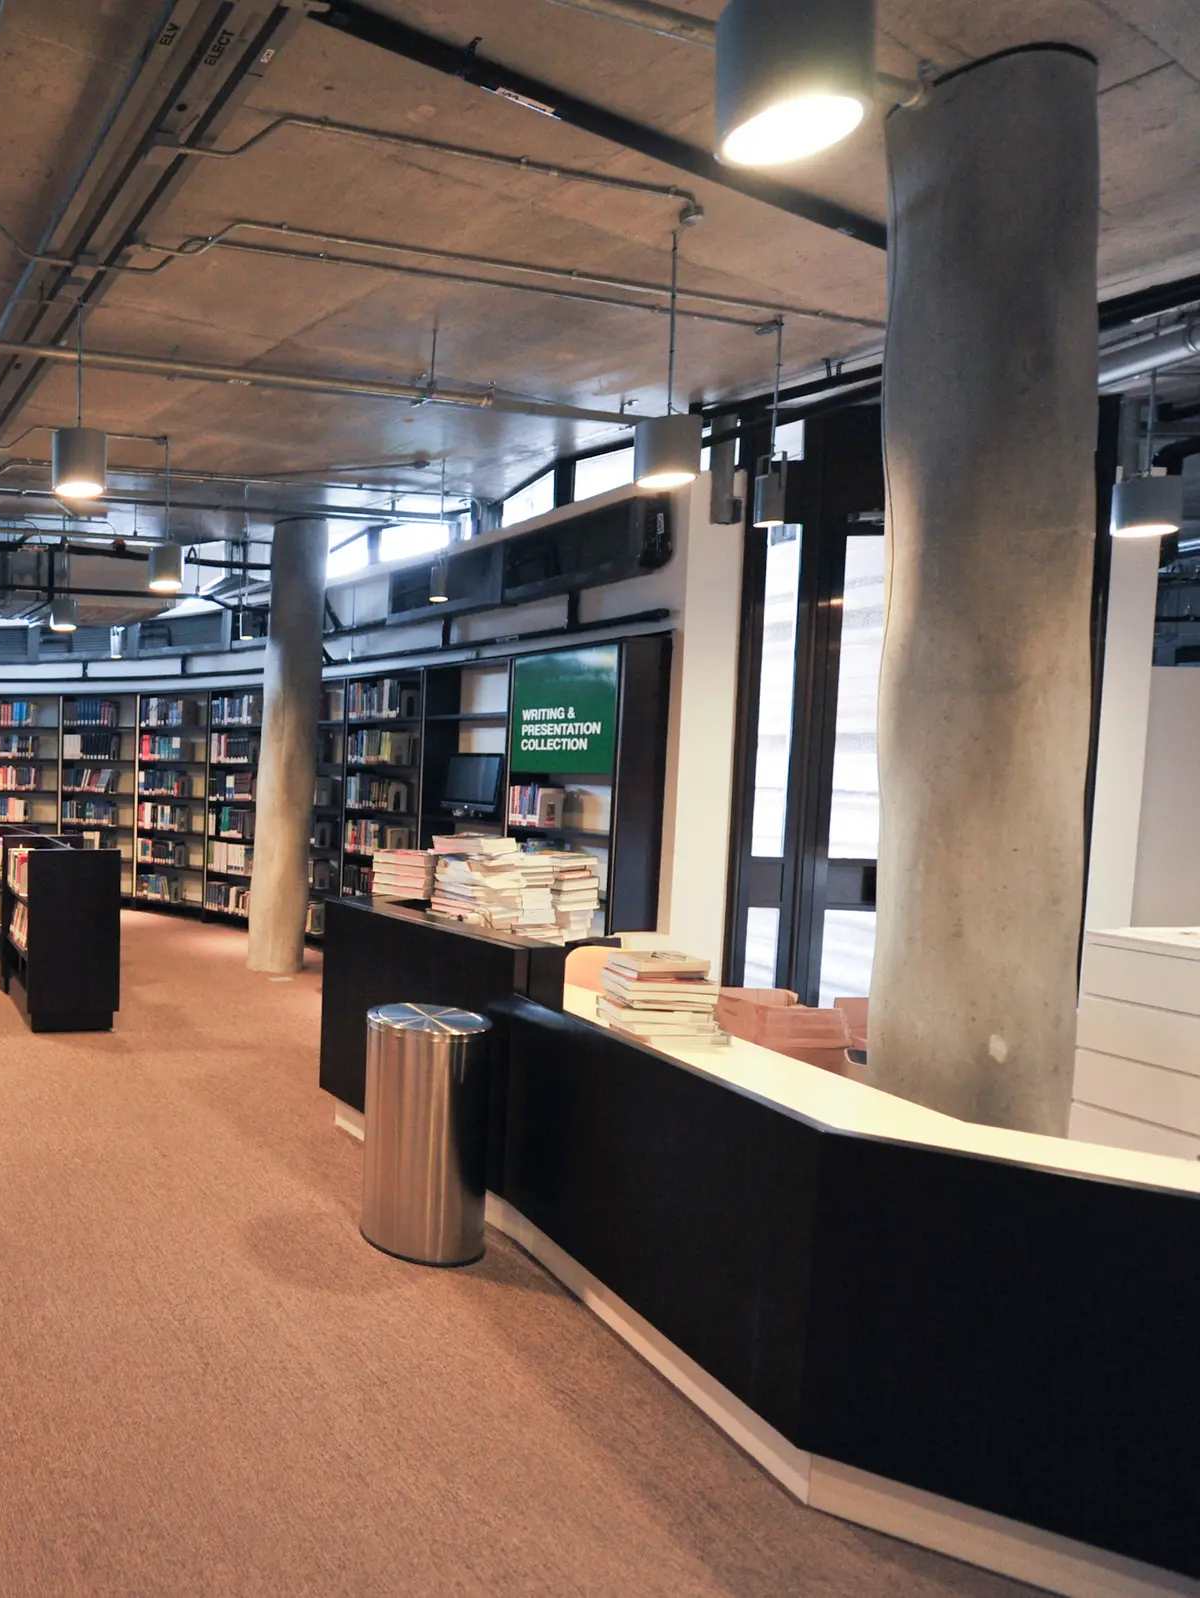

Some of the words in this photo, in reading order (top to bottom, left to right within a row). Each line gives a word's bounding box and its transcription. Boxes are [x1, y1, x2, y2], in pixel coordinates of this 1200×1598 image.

[204, 29, 235, 66] ELECT
[522, 707, 565, 721] WRITING
[567, 706, 576, 719] &
[521, 721, 602, 736] PRESENTATION
[521, 738, 588, 751] COLLECTION
